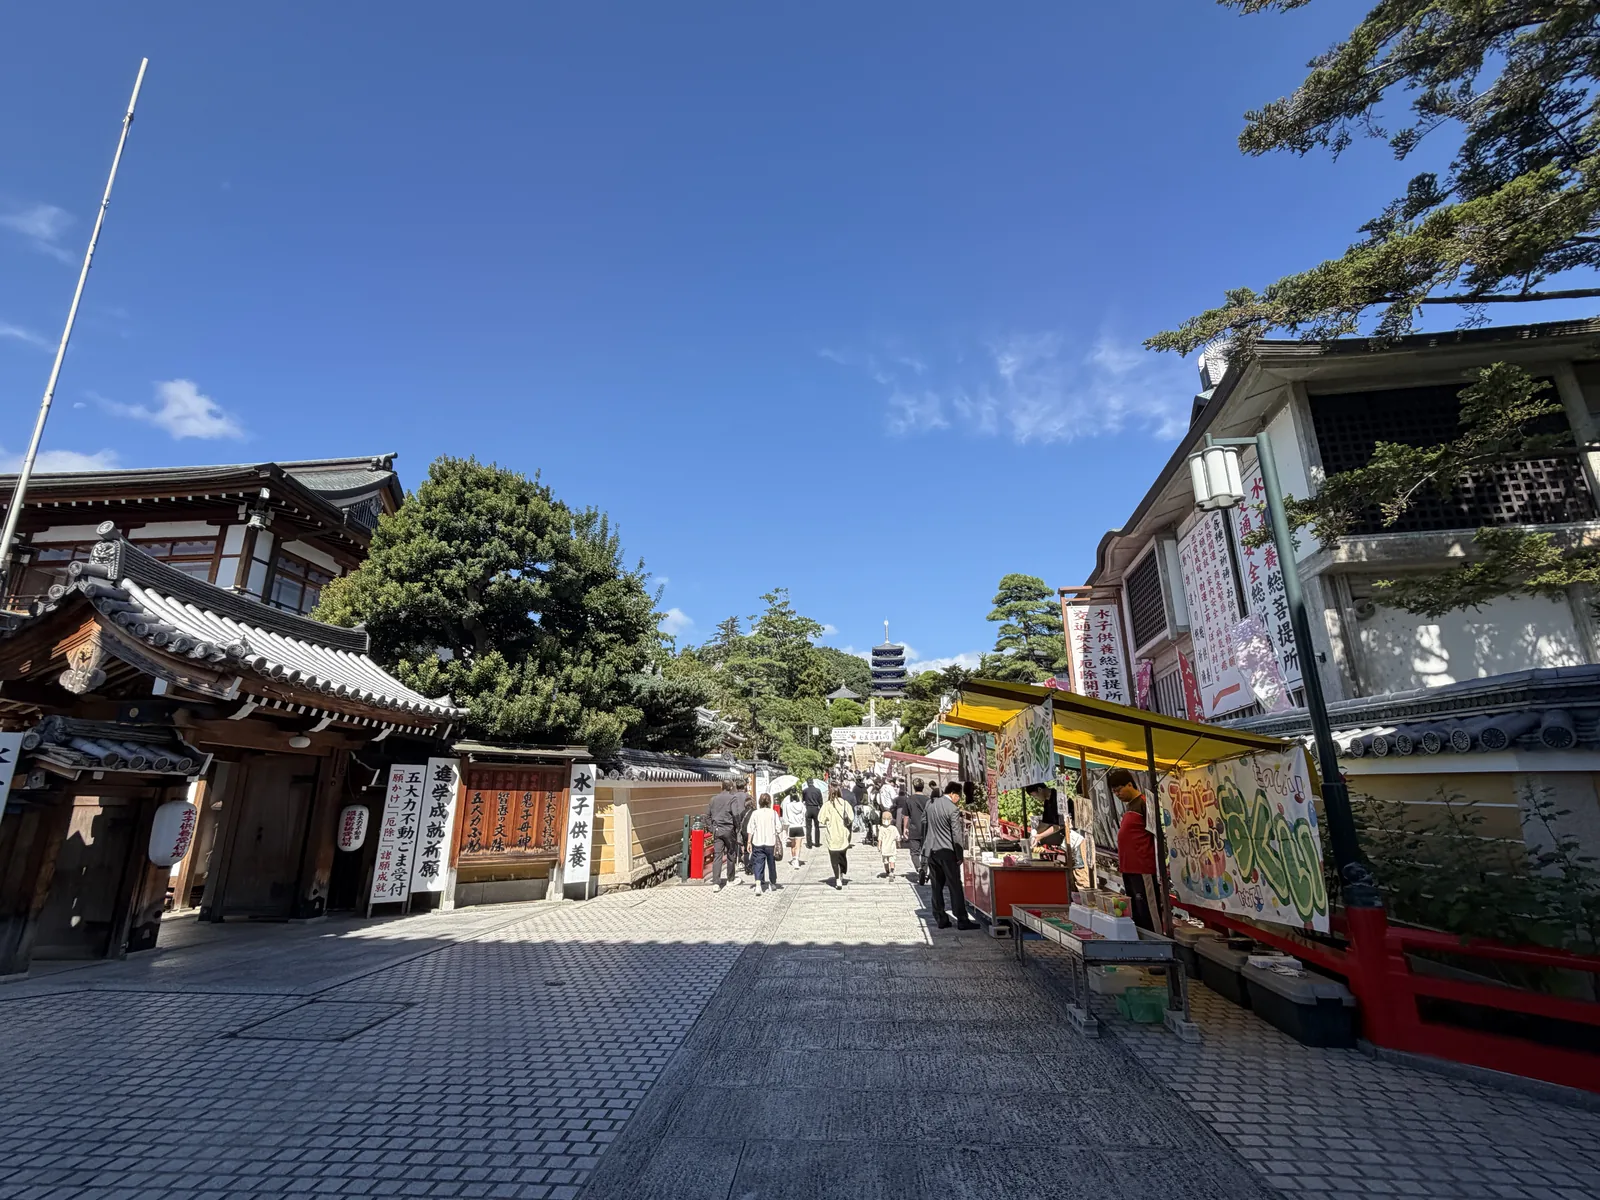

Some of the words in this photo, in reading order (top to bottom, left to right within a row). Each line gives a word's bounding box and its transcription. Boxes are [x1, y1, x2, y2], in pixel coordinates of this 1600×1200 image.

[1095, 608, 1123, 702] 水子供養総菩提所
[388, 771, 422, 897] 五大力不動ごま受付
[419, 764, 453, 878] 進学成就祈願
[516, 791, 534, 851] 鬼子母神
[568, 772, 592, 869] 水子供養
[1168, 779, 1216, 825] スーパー
